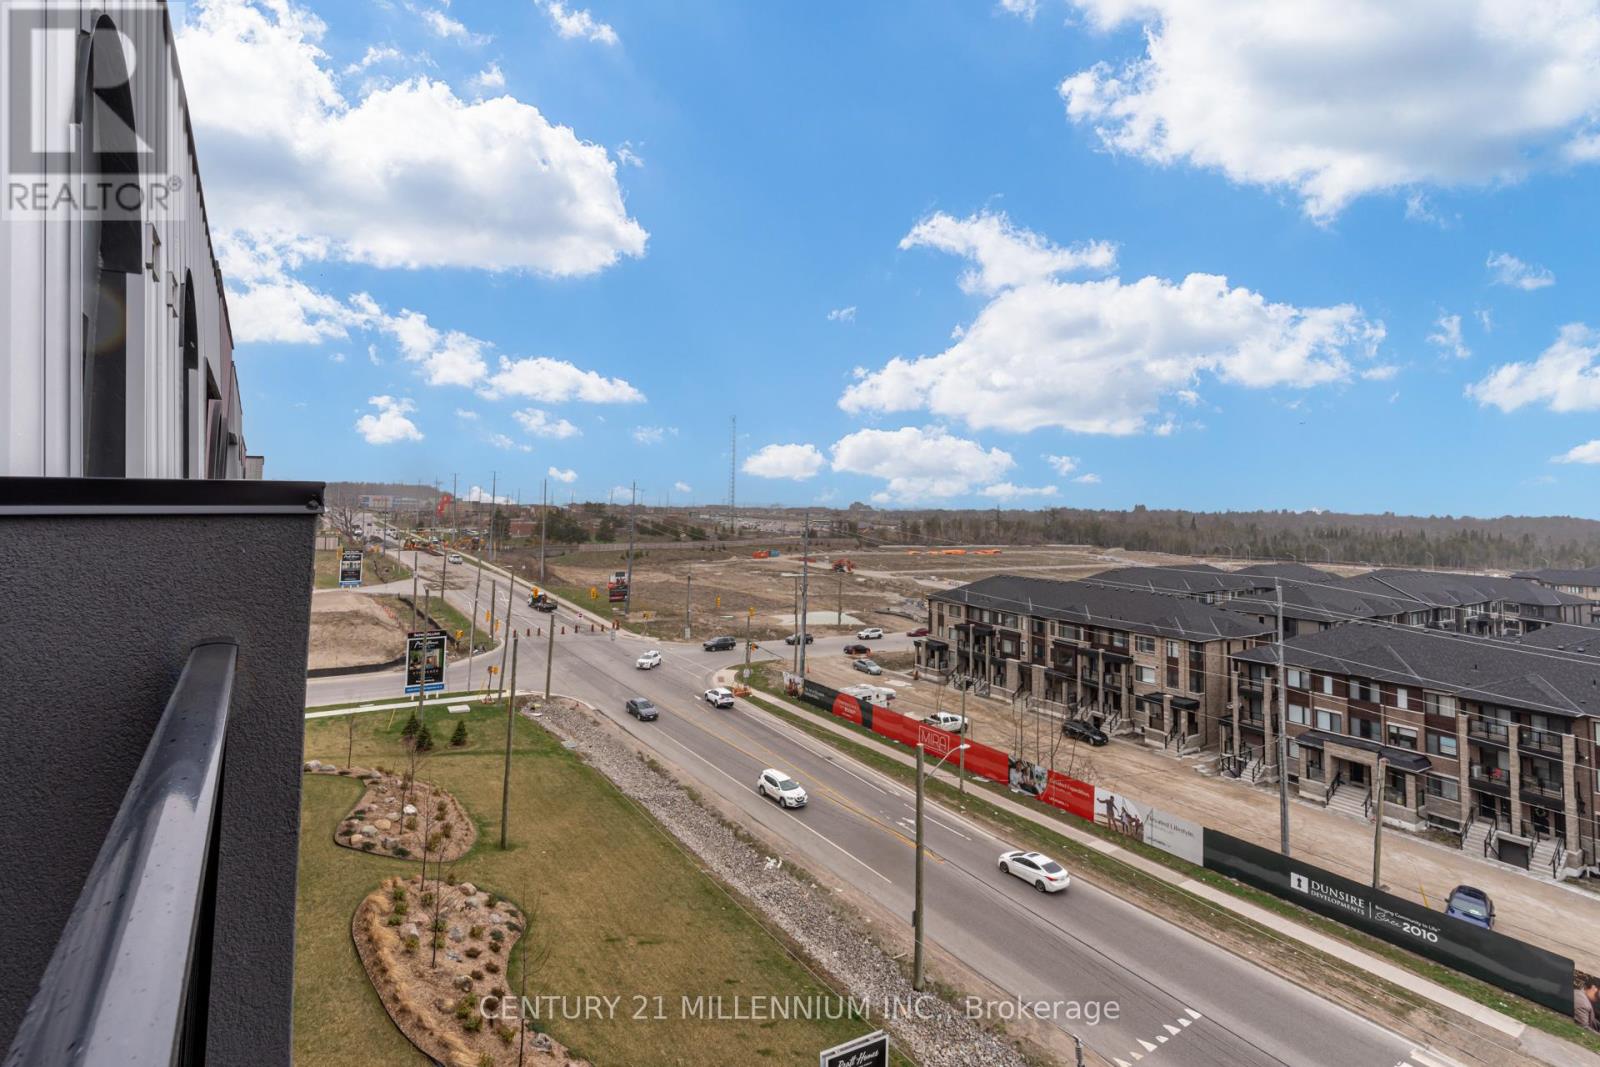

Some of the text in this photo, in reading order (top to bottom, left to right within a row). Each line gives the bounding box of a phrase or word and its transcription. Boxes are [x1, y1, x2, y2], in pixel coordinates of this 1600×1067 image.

[920, 729, 948, 752] MIRA
[1310, 890, 1365, 916] DEVELOPMENTS
[1311, 880, 1365, 909] DUNSIRE
[1402, 922, 1438, 943] 2010
